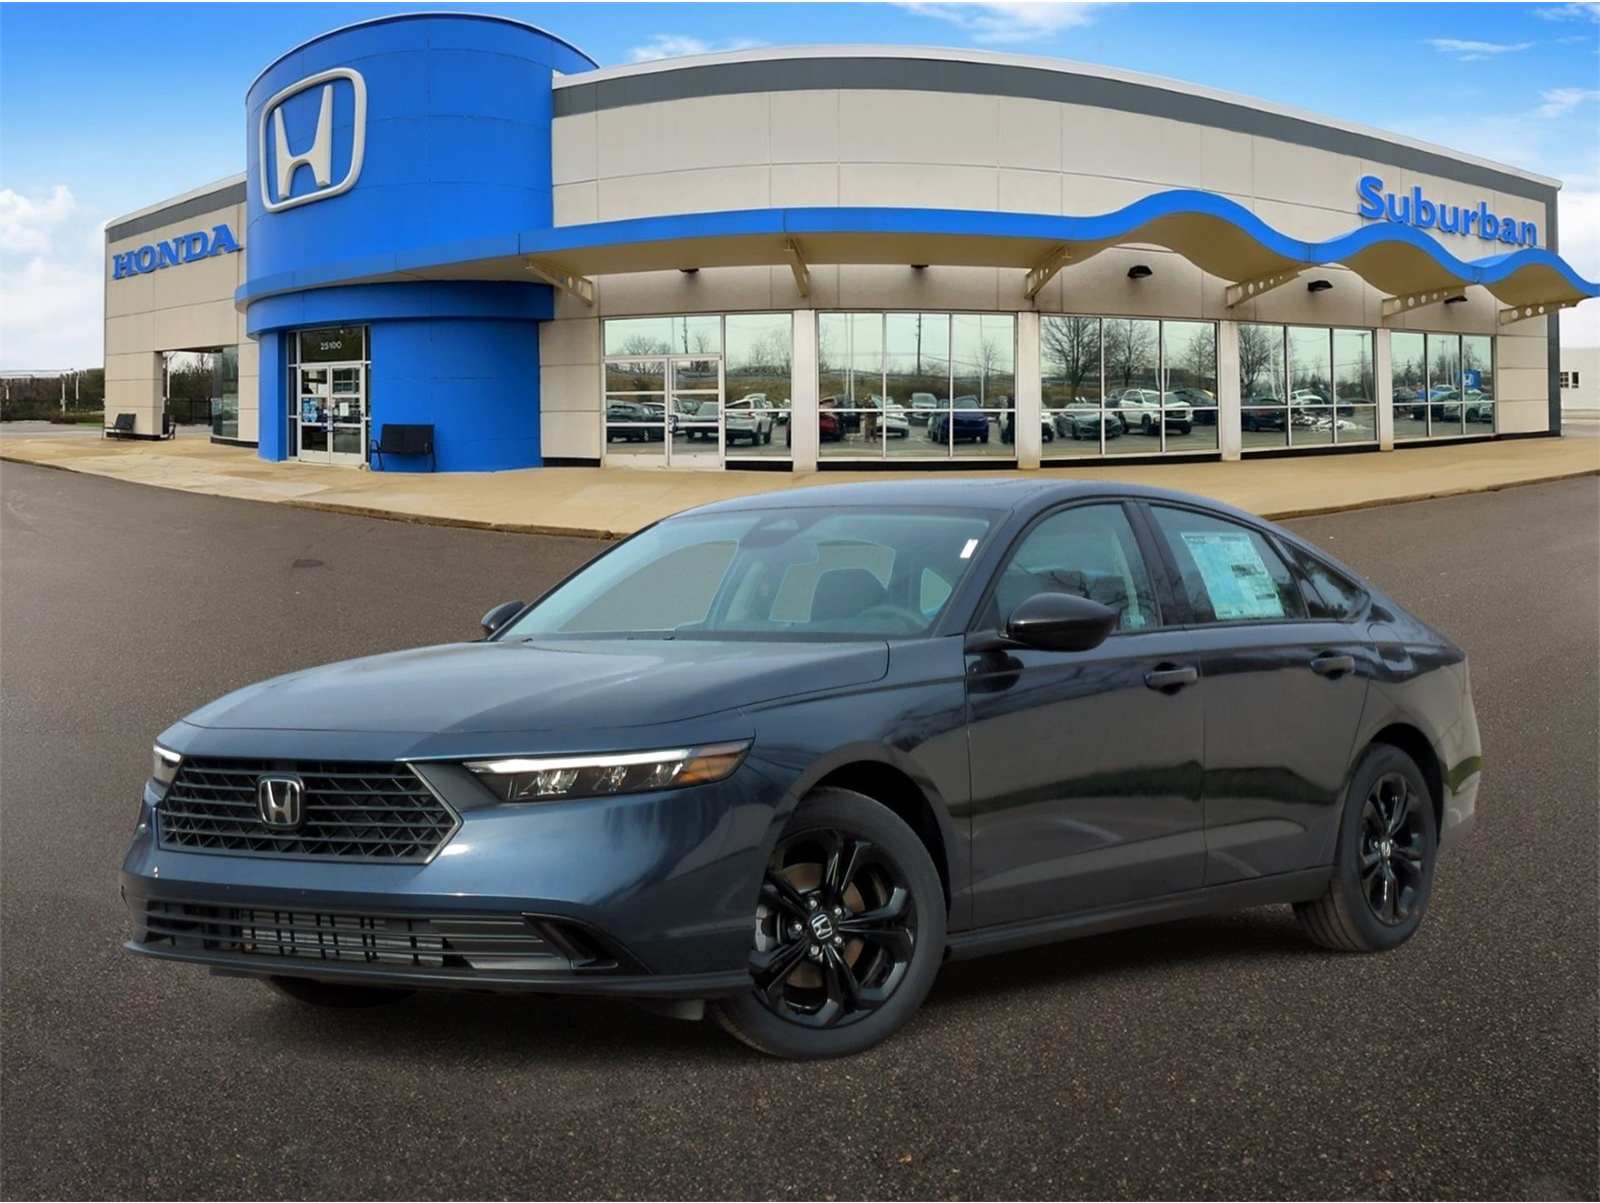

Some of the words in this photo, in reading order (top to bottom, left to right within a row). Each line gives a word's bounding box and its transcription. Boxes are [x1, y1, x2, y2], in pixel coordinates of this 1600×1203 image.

[1358, 175, 1537, 247] Suburban
[112, 223, 241, 279] HONDA
[320, 341, 343, 351] 25100
